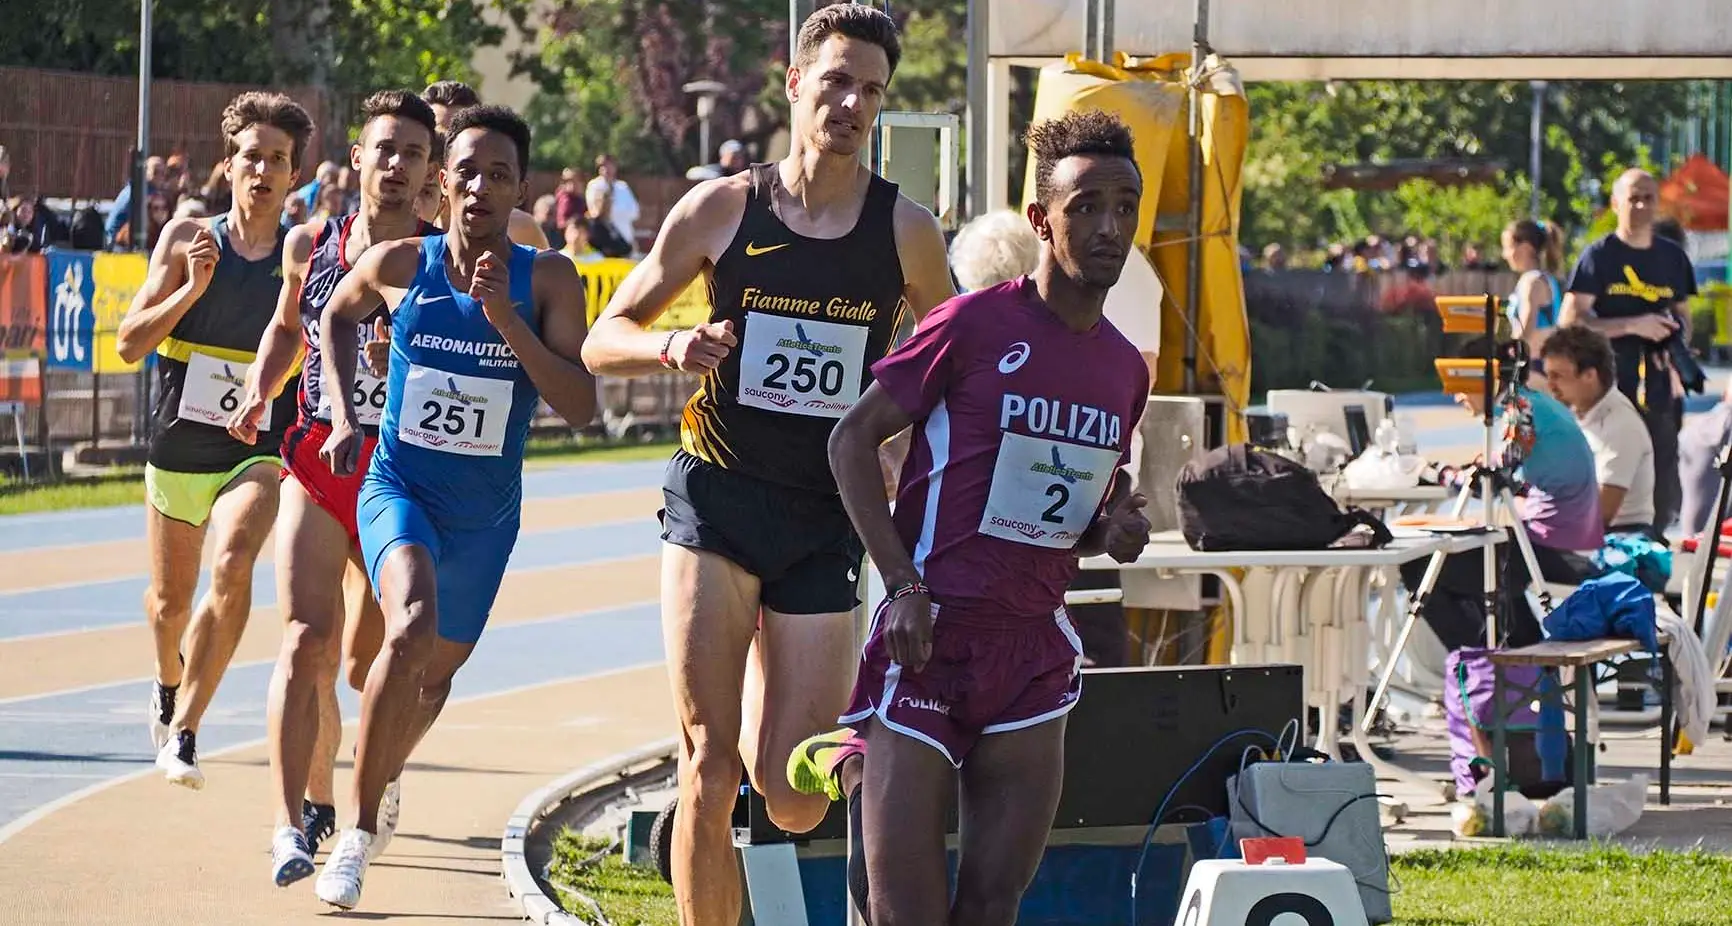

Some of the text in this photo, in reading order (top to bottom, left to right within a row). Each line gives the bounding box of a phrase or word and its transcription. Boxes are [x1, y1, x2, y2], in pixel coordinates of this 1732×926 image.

[741, 286, 878, 321] Fiamme Gialle
[479, 358, 518, 369] MILITARE
[762, 353, 844, 396] 250
[220, 388, 239, 412] 6
[744, 387, 787, 403] saucony
[419, 400, 486, 438] 251
[1000, 394, 1121, 446] POLIZIA
[403, 427, 440, 442] saucony
[1041, 484, 1070, 524] 2
[990, 516, 1037, 534] saucony
[897, 696, 951, 715] POLIZ
